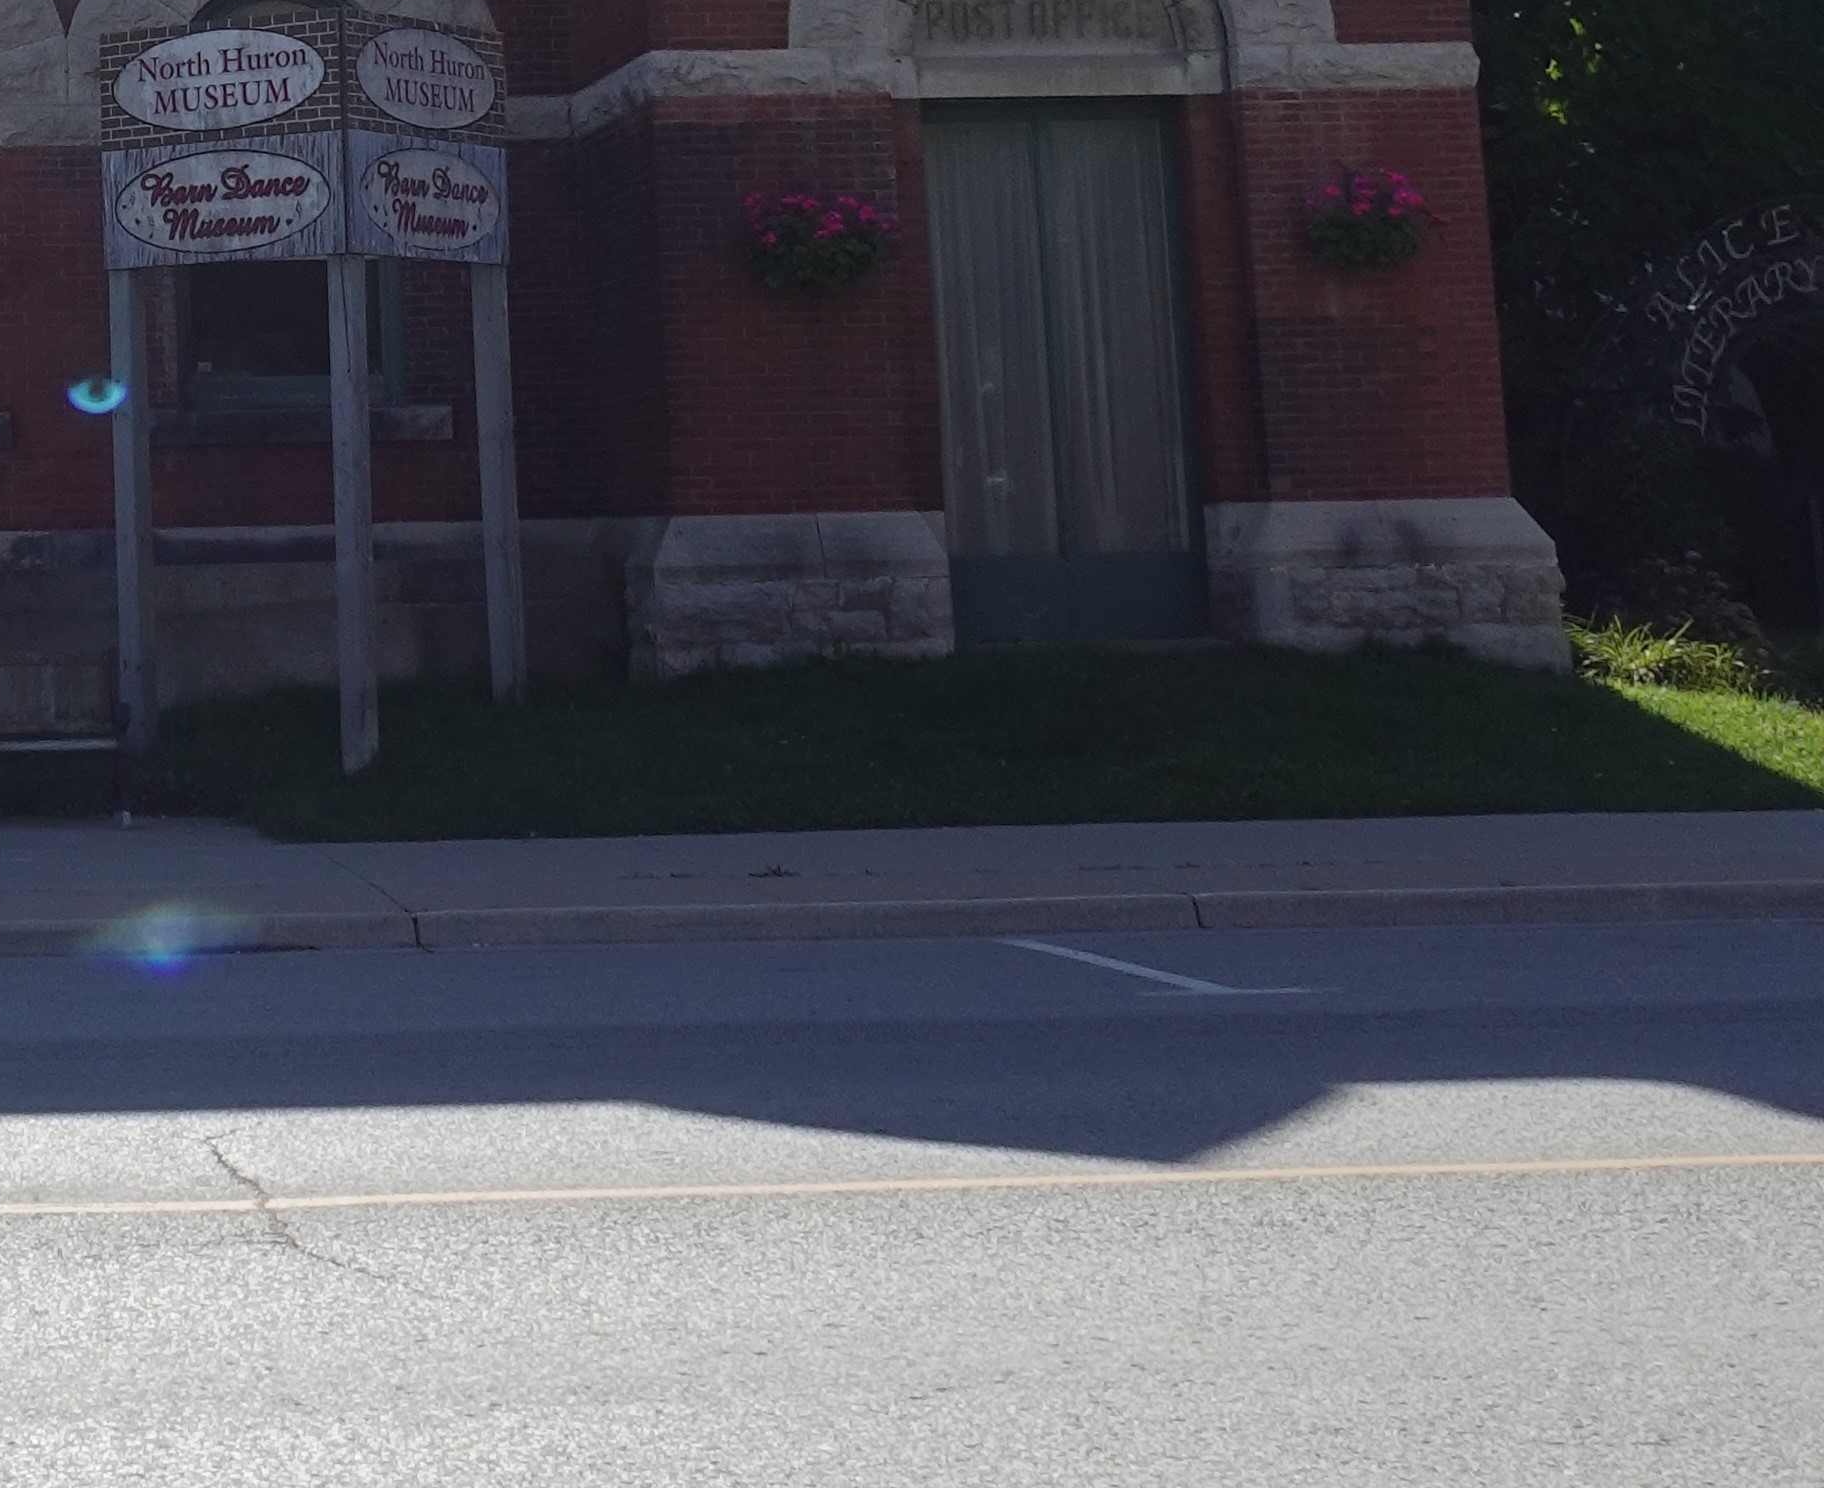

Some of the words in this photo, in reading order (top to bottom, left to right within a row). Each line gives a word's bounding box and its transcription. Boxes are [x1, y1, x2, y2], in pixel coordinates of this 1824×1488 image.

[926, 0, 1013, 40] POST
[137, 49, 212, 84] North
[219, 44, 309, 76] Huron
[373, 41, 425, 73] North
[429, 49, 486, 81] Huron
[153, 76, 293, 116] MUSEUM
[384, 76, 476, 114] MUSEUM
[140, 172, 218, 208] Barn
[220, 163, 311, 201] Dance
[377, 161, 430, 198] Barn
[432, 165, 489, 205] Dance
[162, 207, 282, 242] Museum
[392, 198, 470, 239] Museum
[1646, 204, 1801, 332] ALICE
[1670, 255, 1824, 437] LITERARY
